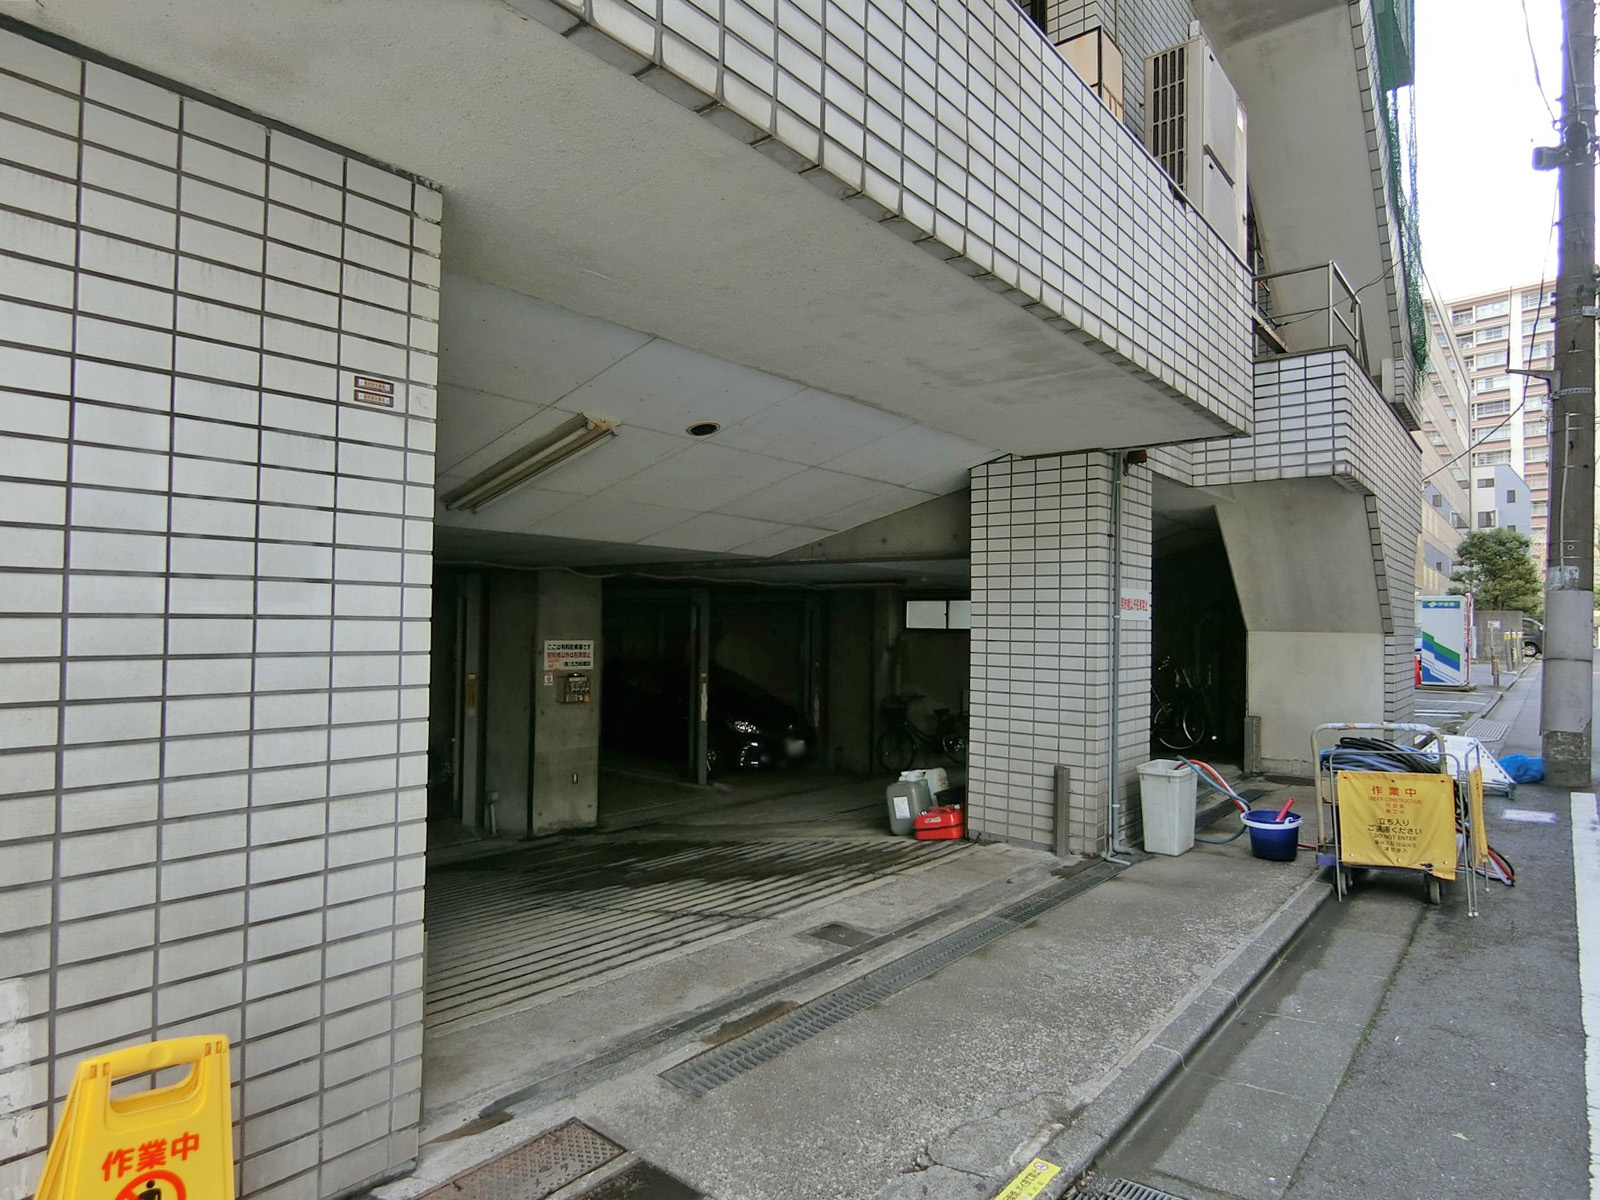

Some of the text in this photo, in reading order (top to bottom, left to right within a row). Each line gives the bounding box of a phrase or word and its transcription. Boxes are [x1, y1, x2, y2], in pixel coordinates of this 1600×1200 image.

[1371, 785, 1417, 797] 作業中
[1378, 818, 1409, 826] 立ち入り
[1368, 824, 1422, 834] ご遠慮ください
[102, 1132, 199, 1181] 作業中
